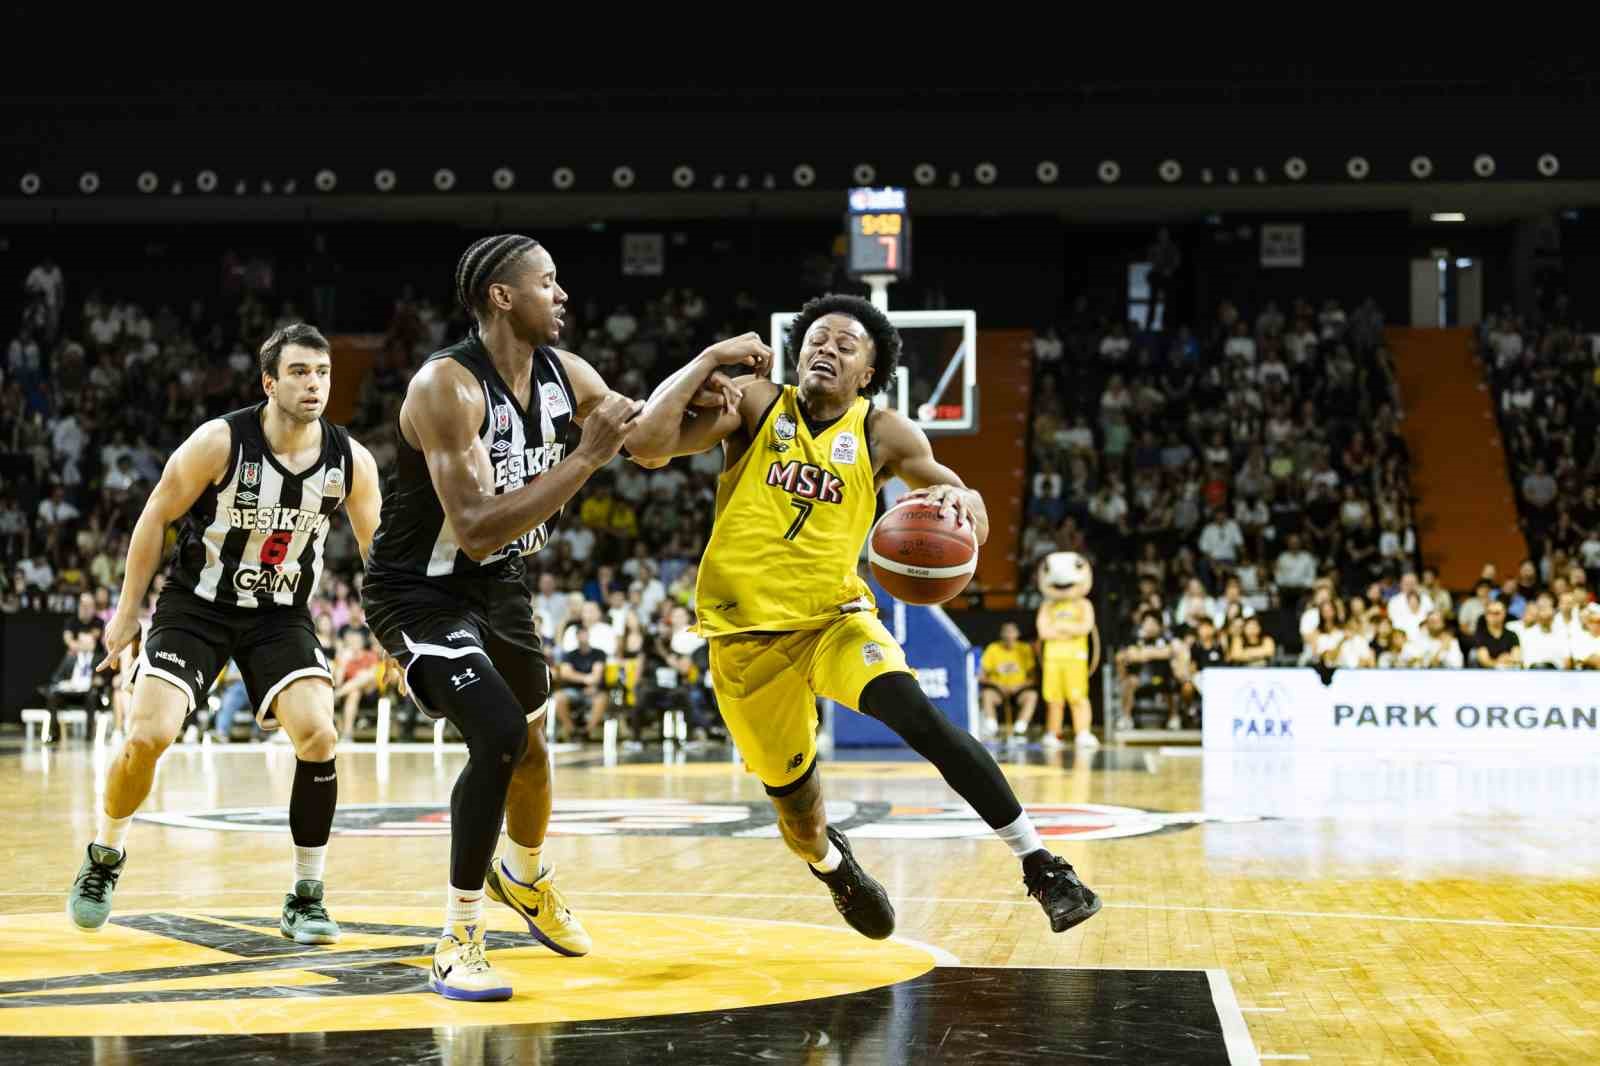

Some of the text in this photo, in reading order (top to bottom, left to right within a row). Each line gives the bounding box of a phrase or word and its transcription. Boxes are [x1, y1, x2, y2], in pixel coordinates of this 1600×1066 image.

[880, 237, 897, 270] 7
[766, 460, 845, 504] MSK
[228, 503, 328, 536] BEŞİKTA
[784, 497, 814, 541] 7
[260, 532, 293, 565] 6
[1232, 718, 1294, 737] PARK
[1334, 704, 1598, 729] PARK ORGAN
